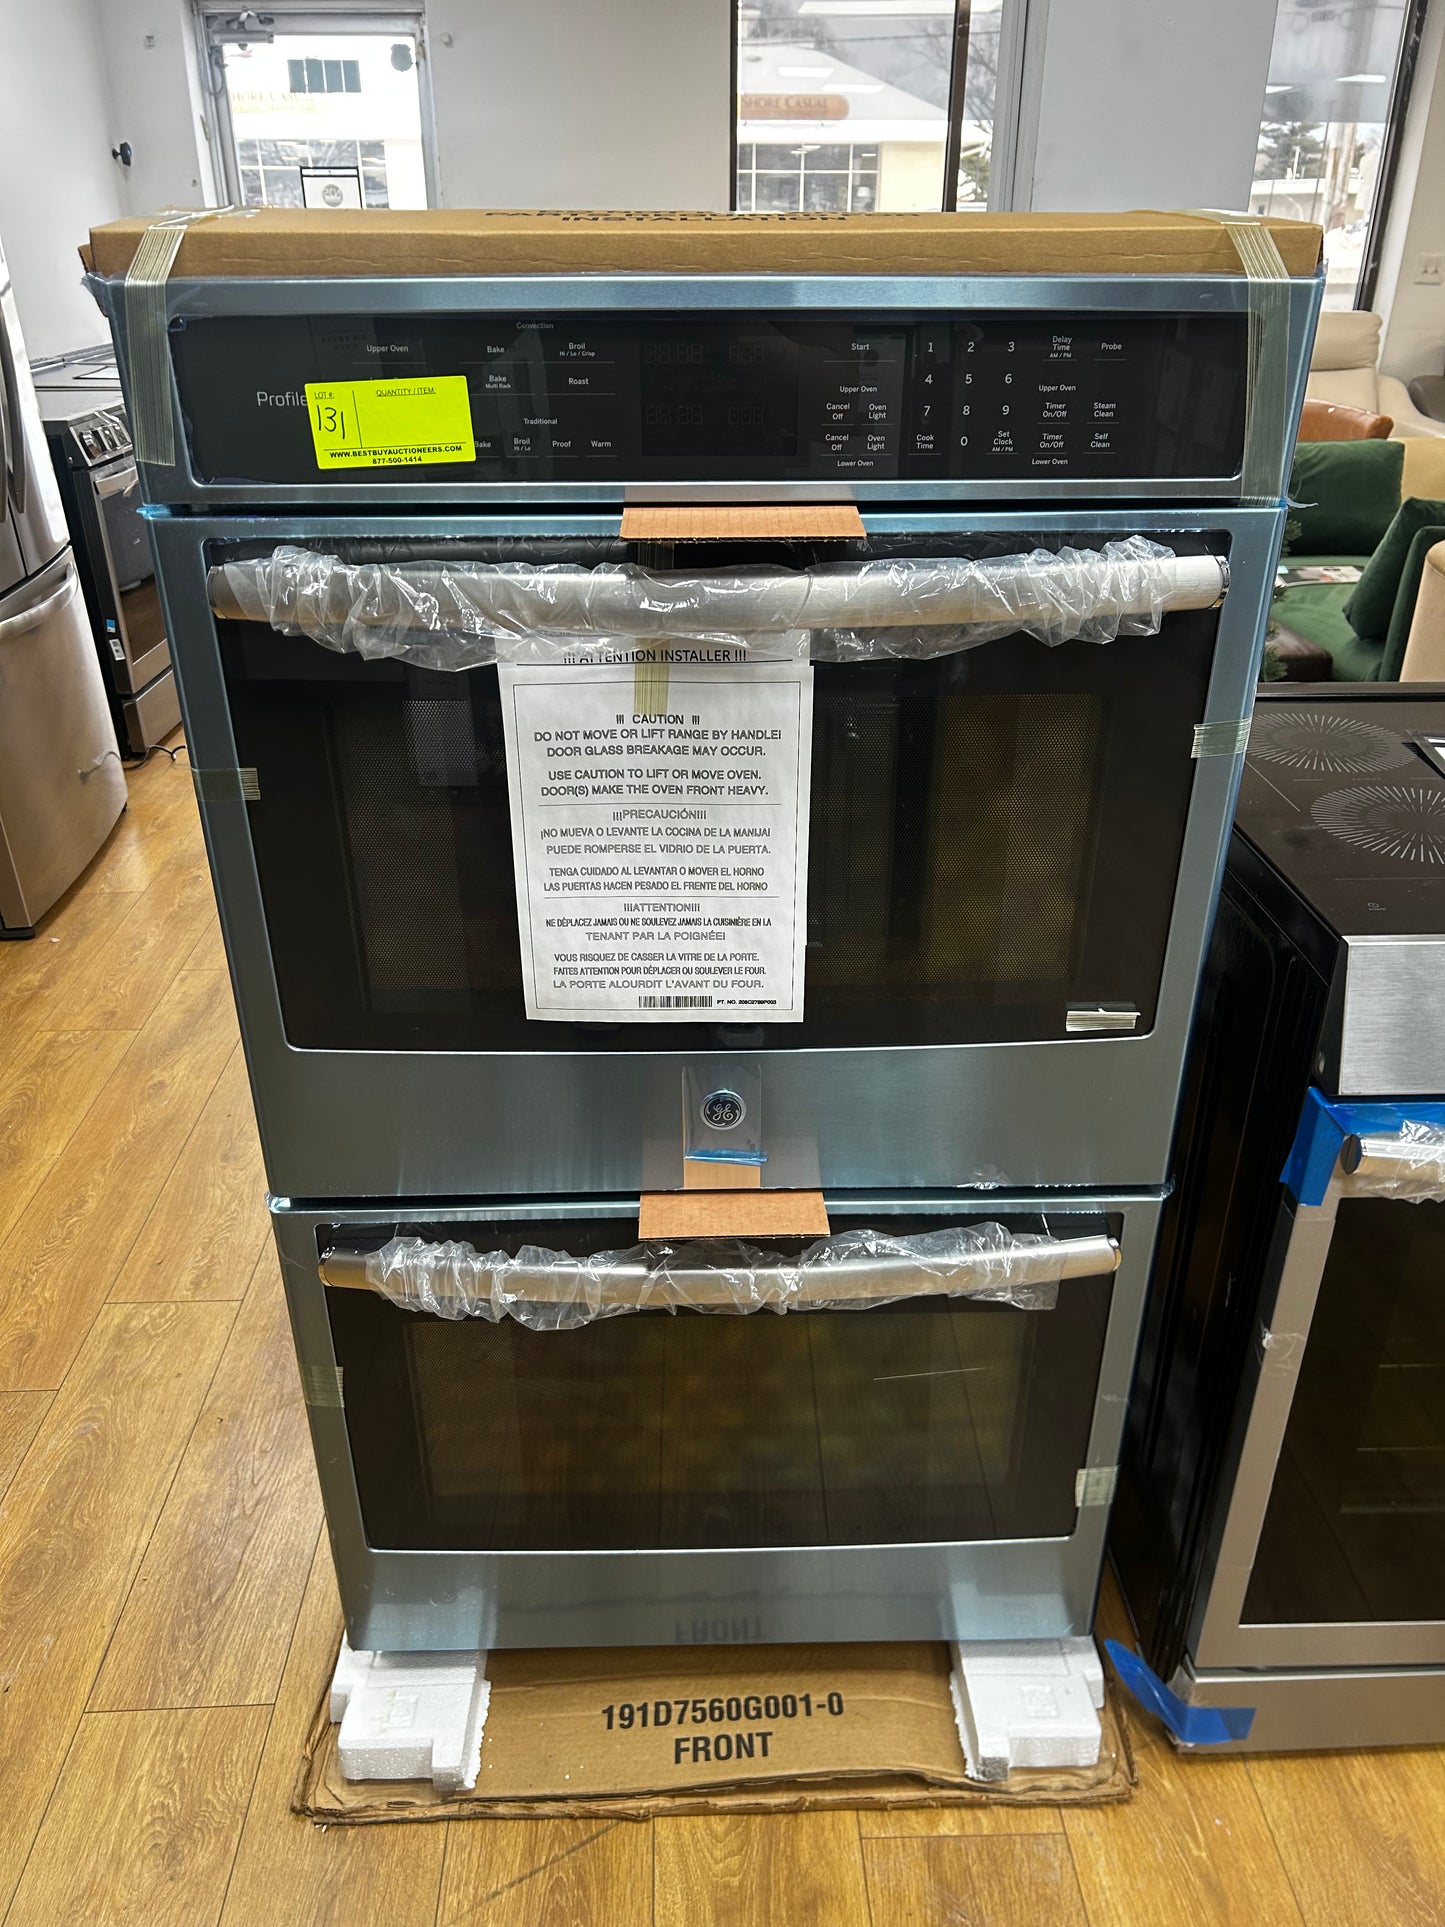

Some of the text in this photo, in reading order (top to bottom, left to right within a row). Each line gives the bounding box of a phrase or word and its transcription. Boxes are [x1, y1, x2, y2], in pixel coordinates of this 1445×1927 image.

[1053, 336, 1072, 344] Delay
[367, 345, 387, 353] Upper
[928, 342, 933, 352] 1
[968, 342, 974, 352] 2
[1008, 342, 1014, 352] 3
[925, 375, 932, 384] 4
[966, 374, 972, 384] 5
[1005, 374, 1012, 383] 6
[314, 391, 327, 399] LOT
[375, 387, 437, 398] QUANTITY ITEM:
[257, 391, 308, 407] Profile
[924, 406, 930, 416] 7
[963, 405, 970, 415] 8
[1003, 405, 1009, 415] 9
[869, 412, 886, 420] Light
[316, 404, 346, 440] 131
[961, 437, 968, 446] 0
[329, 445, 463, 458] WWW.BESTBUYAUCTIONEERS.COM
[868, 443, 884, 451] Light
[372, 456, 423, 465] 877-500-1414
[661, 649, 730, 662] INSTALLER
[633, 714, 684, 724] CAUTION
[534, 732, 552, 741] DO
[555, 731, 580, 741] NOT
[583, 729, 617, 740] MOVE
[621, 729, 638, 738] OR
[642, 729, 665, 738] LIFT
[668, 729, 709, 739] RANGE
[712, 730, 728, 740] BY
[547, 745, 765, 757] DOOR GLASS BREAKAGE MAY OCCUR.
[549, 769, 761, 780] USE CAUTION TO LIFT OR MOVE OVEN.
[541, 784, 768, 797] DOOR(S) MAKE THE OVEN FRONT HEAVY.
[560, 828, 594, 837] MUEVA
[596, 827, 604, 836] O
[606, 827, 648, 836] LEVANTE
[652, 827, 663, 836] LA
[665, 827, 701, 836] COCINA
[704, 828, 717, 837] DE
[720, 828, 731, 837] LA
[547, 844, 771, 854] PUEDE ROMPERSE EL VIDRIO DE LA PUERTA.
[549, 866, 764, 876] TENGA CUIDADO AL LEVANTAR O MOVER EL HORNO
[544, 881, 768, 891] LAS PUERTAS HACEN PESADO EL FRENTE DEL HORNO
[554, 953, 759, 962] VOUS RISQUEZ DE CASSER LA VITRE DE LA PORTE.
[553, 980, 567, 988] LA
[609, 980, 663, 988] ALOURDIT
[666, 980, 710, 988] L'AVANT
[713, 980, 728, 988] DU
[731, 980, 764, 988] FOUR.
[602, 1692, 844, 1730] 191D7560G001-0
[674, 1731, 773, 1765] FRONT
